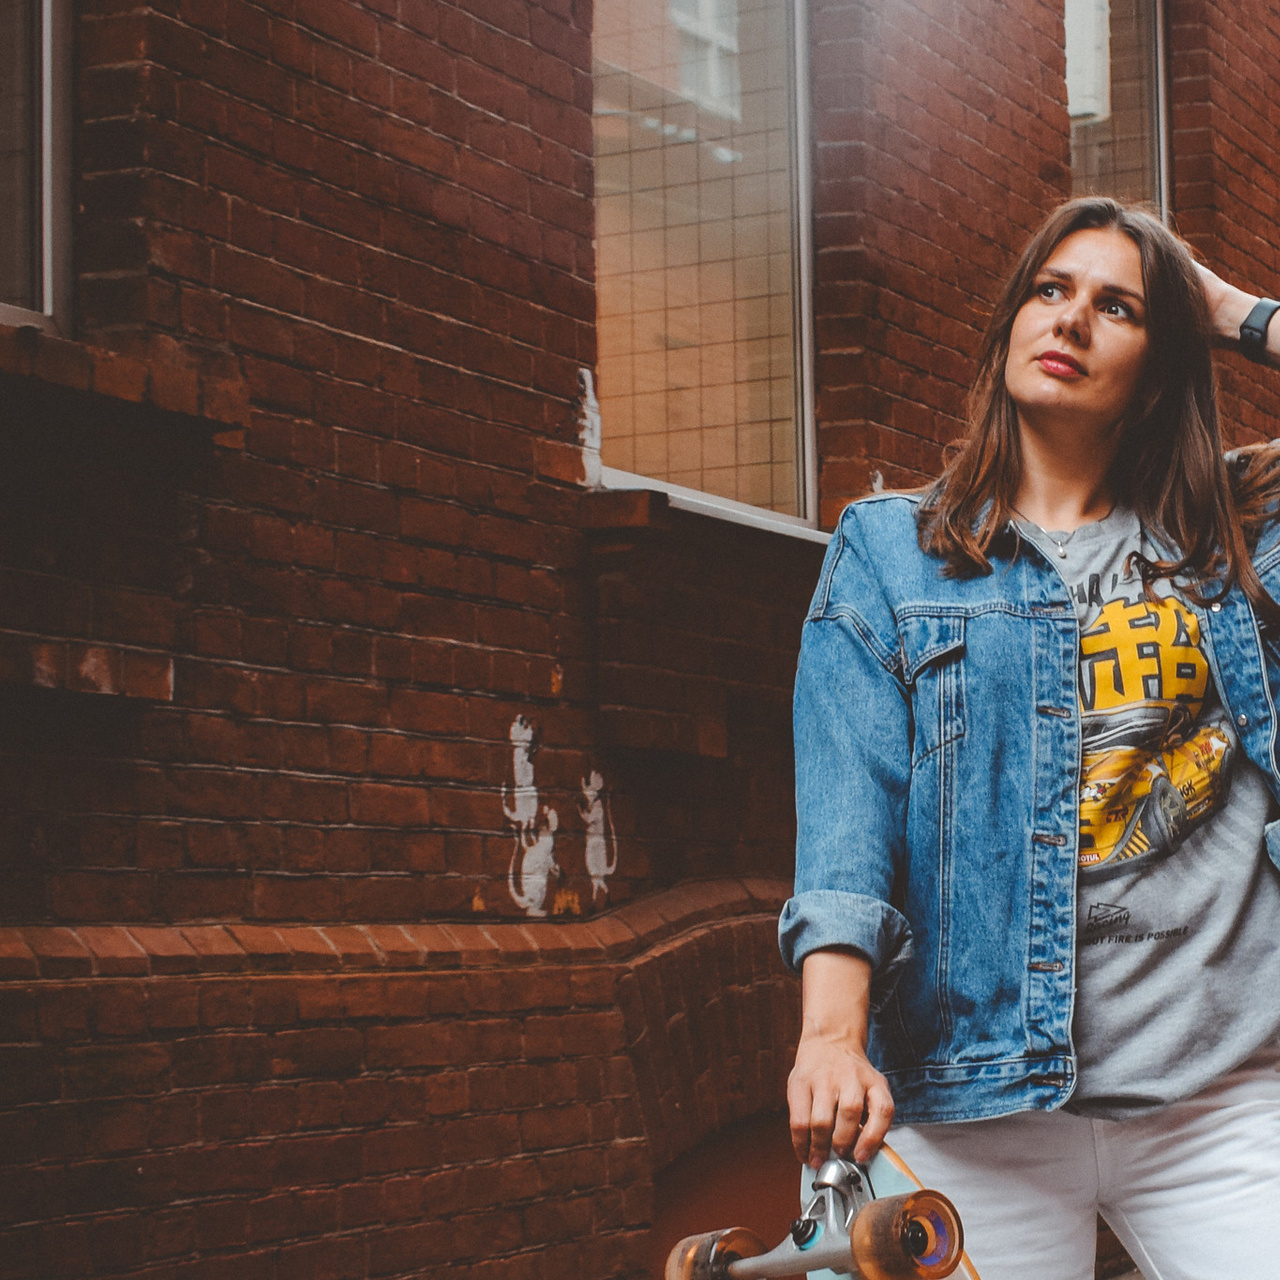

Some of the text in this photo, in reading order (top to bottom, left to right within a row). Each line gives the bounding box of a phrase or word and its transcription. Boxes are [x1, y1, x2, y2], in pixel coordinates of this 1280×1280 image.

[1079, 853, 1100, 862] OTUL
[1108, 935, 1132, 944] FIRE
[1135, 933, 1144, 942] IS
[1147, 925, 1189, 940] POSSIBLE
